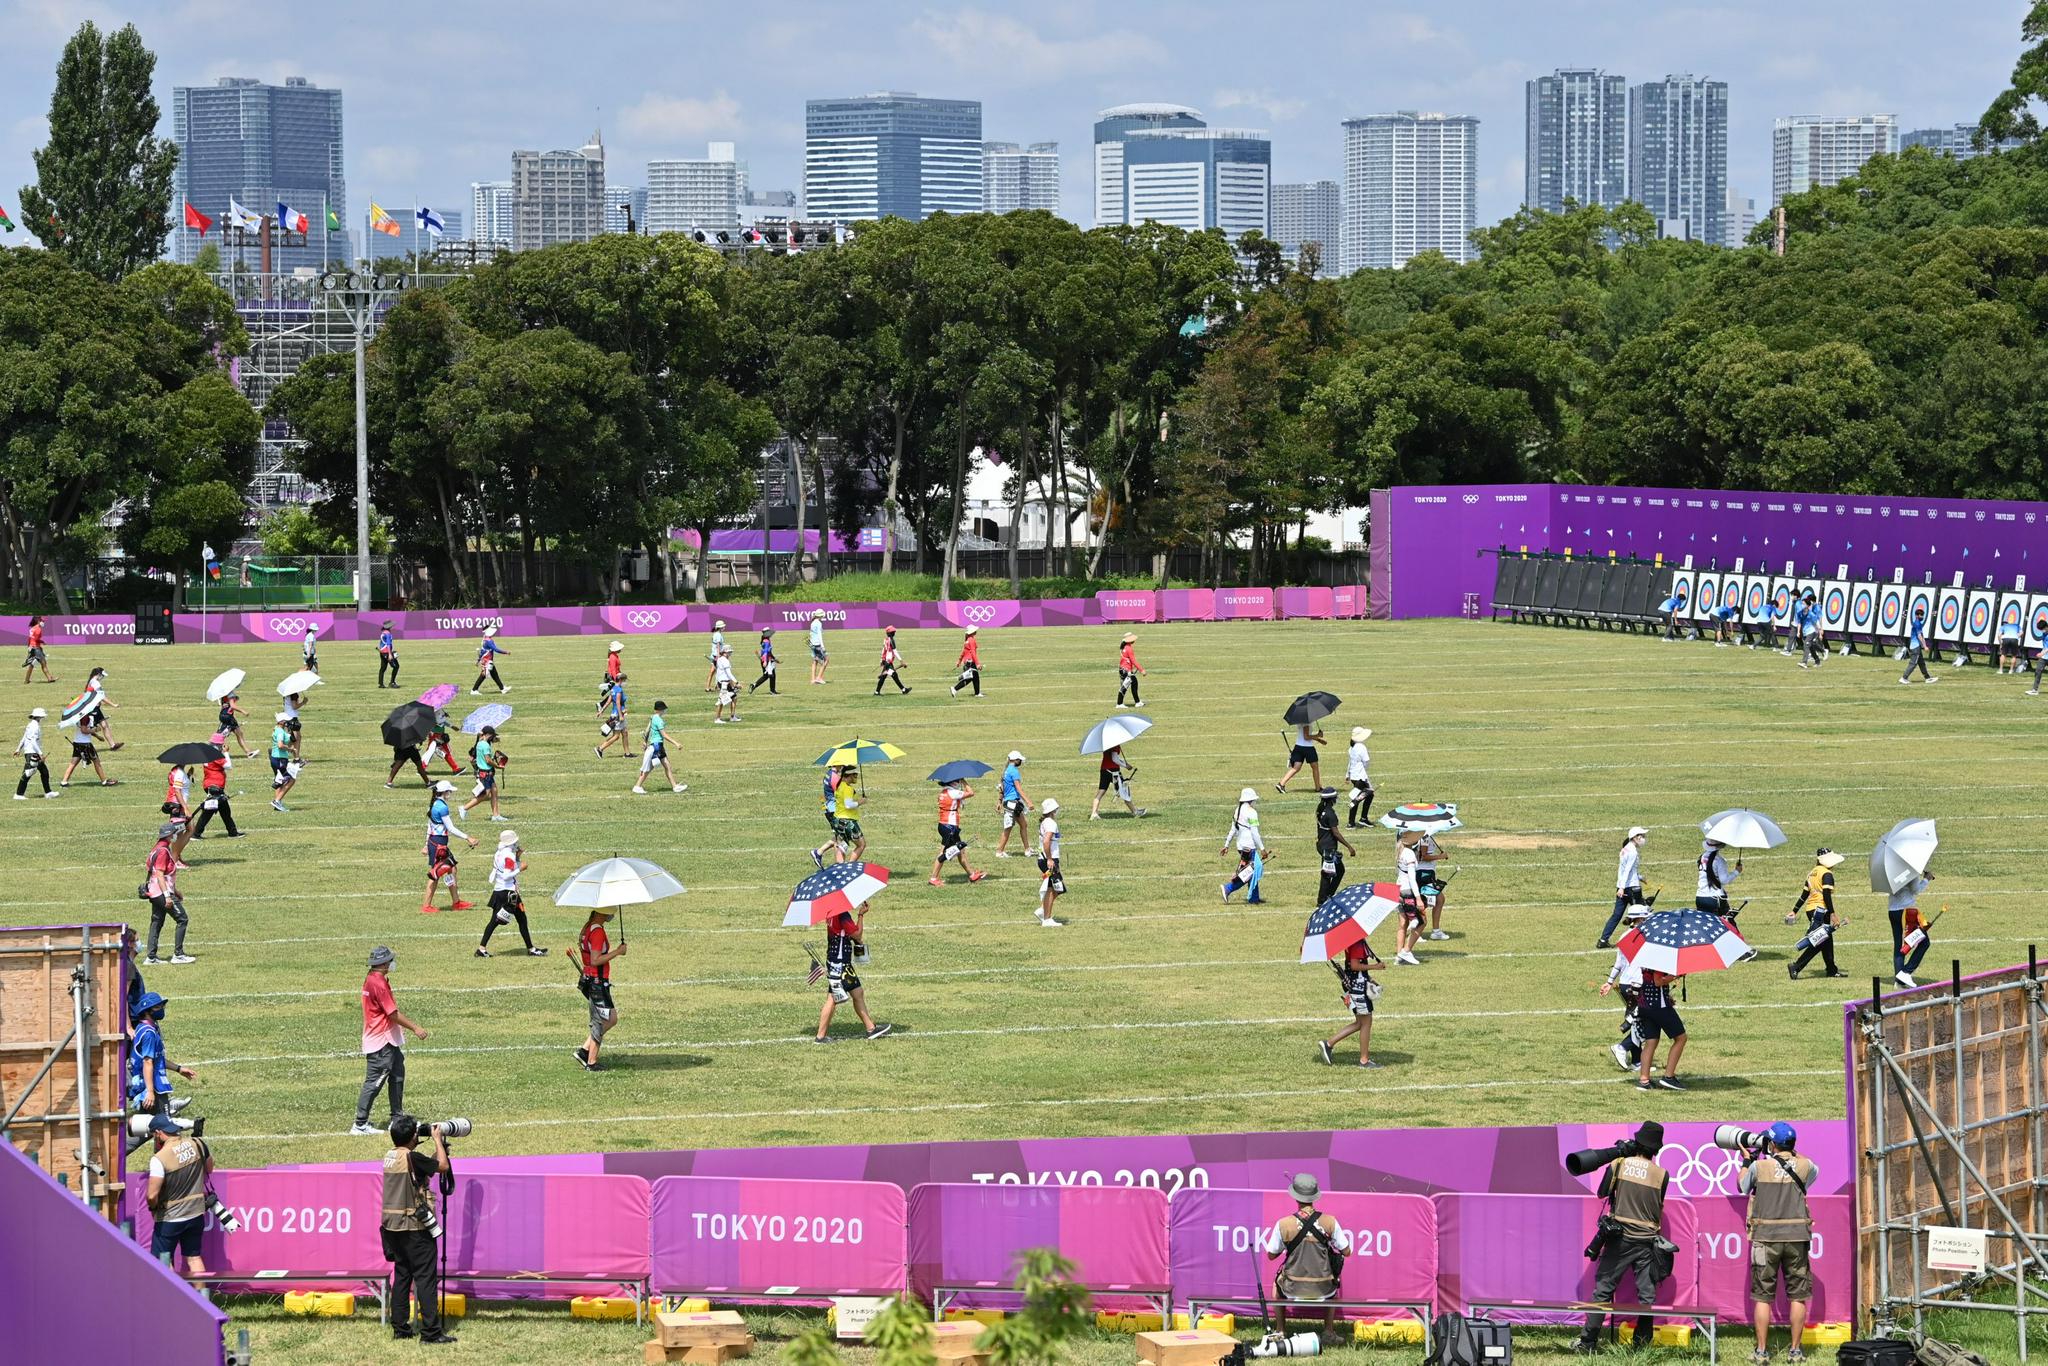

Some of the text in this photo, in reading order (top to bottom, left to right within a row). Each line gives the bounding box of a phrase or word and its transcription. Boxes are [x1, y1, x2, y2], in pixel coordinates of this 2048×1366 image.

[1711, 558, 1716, 570] 2
[1760, 561, 1765, 573] 4
[1811, 564, 1816, 577] 6
[1839, 567, 1845, 579] 7
[1867, 568, 1873, 581] 8
[1925, 571, 1932, 584] 10
[1985, 575, 1993, 588] 12
[2017, 577, 2024, 590] 13
[1128, 599, 1146, 607] 2020
[1247, 596, 1264, 604] 2020
[64, 623, 136, 635] TOKYO 2020
[435, 618, 473, 629] TOKYO
[1623, 1165, 1648, 1180] 2030
[281, 1207, 352, 1233] 2020
[692, 1213, 863, 1245] TOKYO 2020
